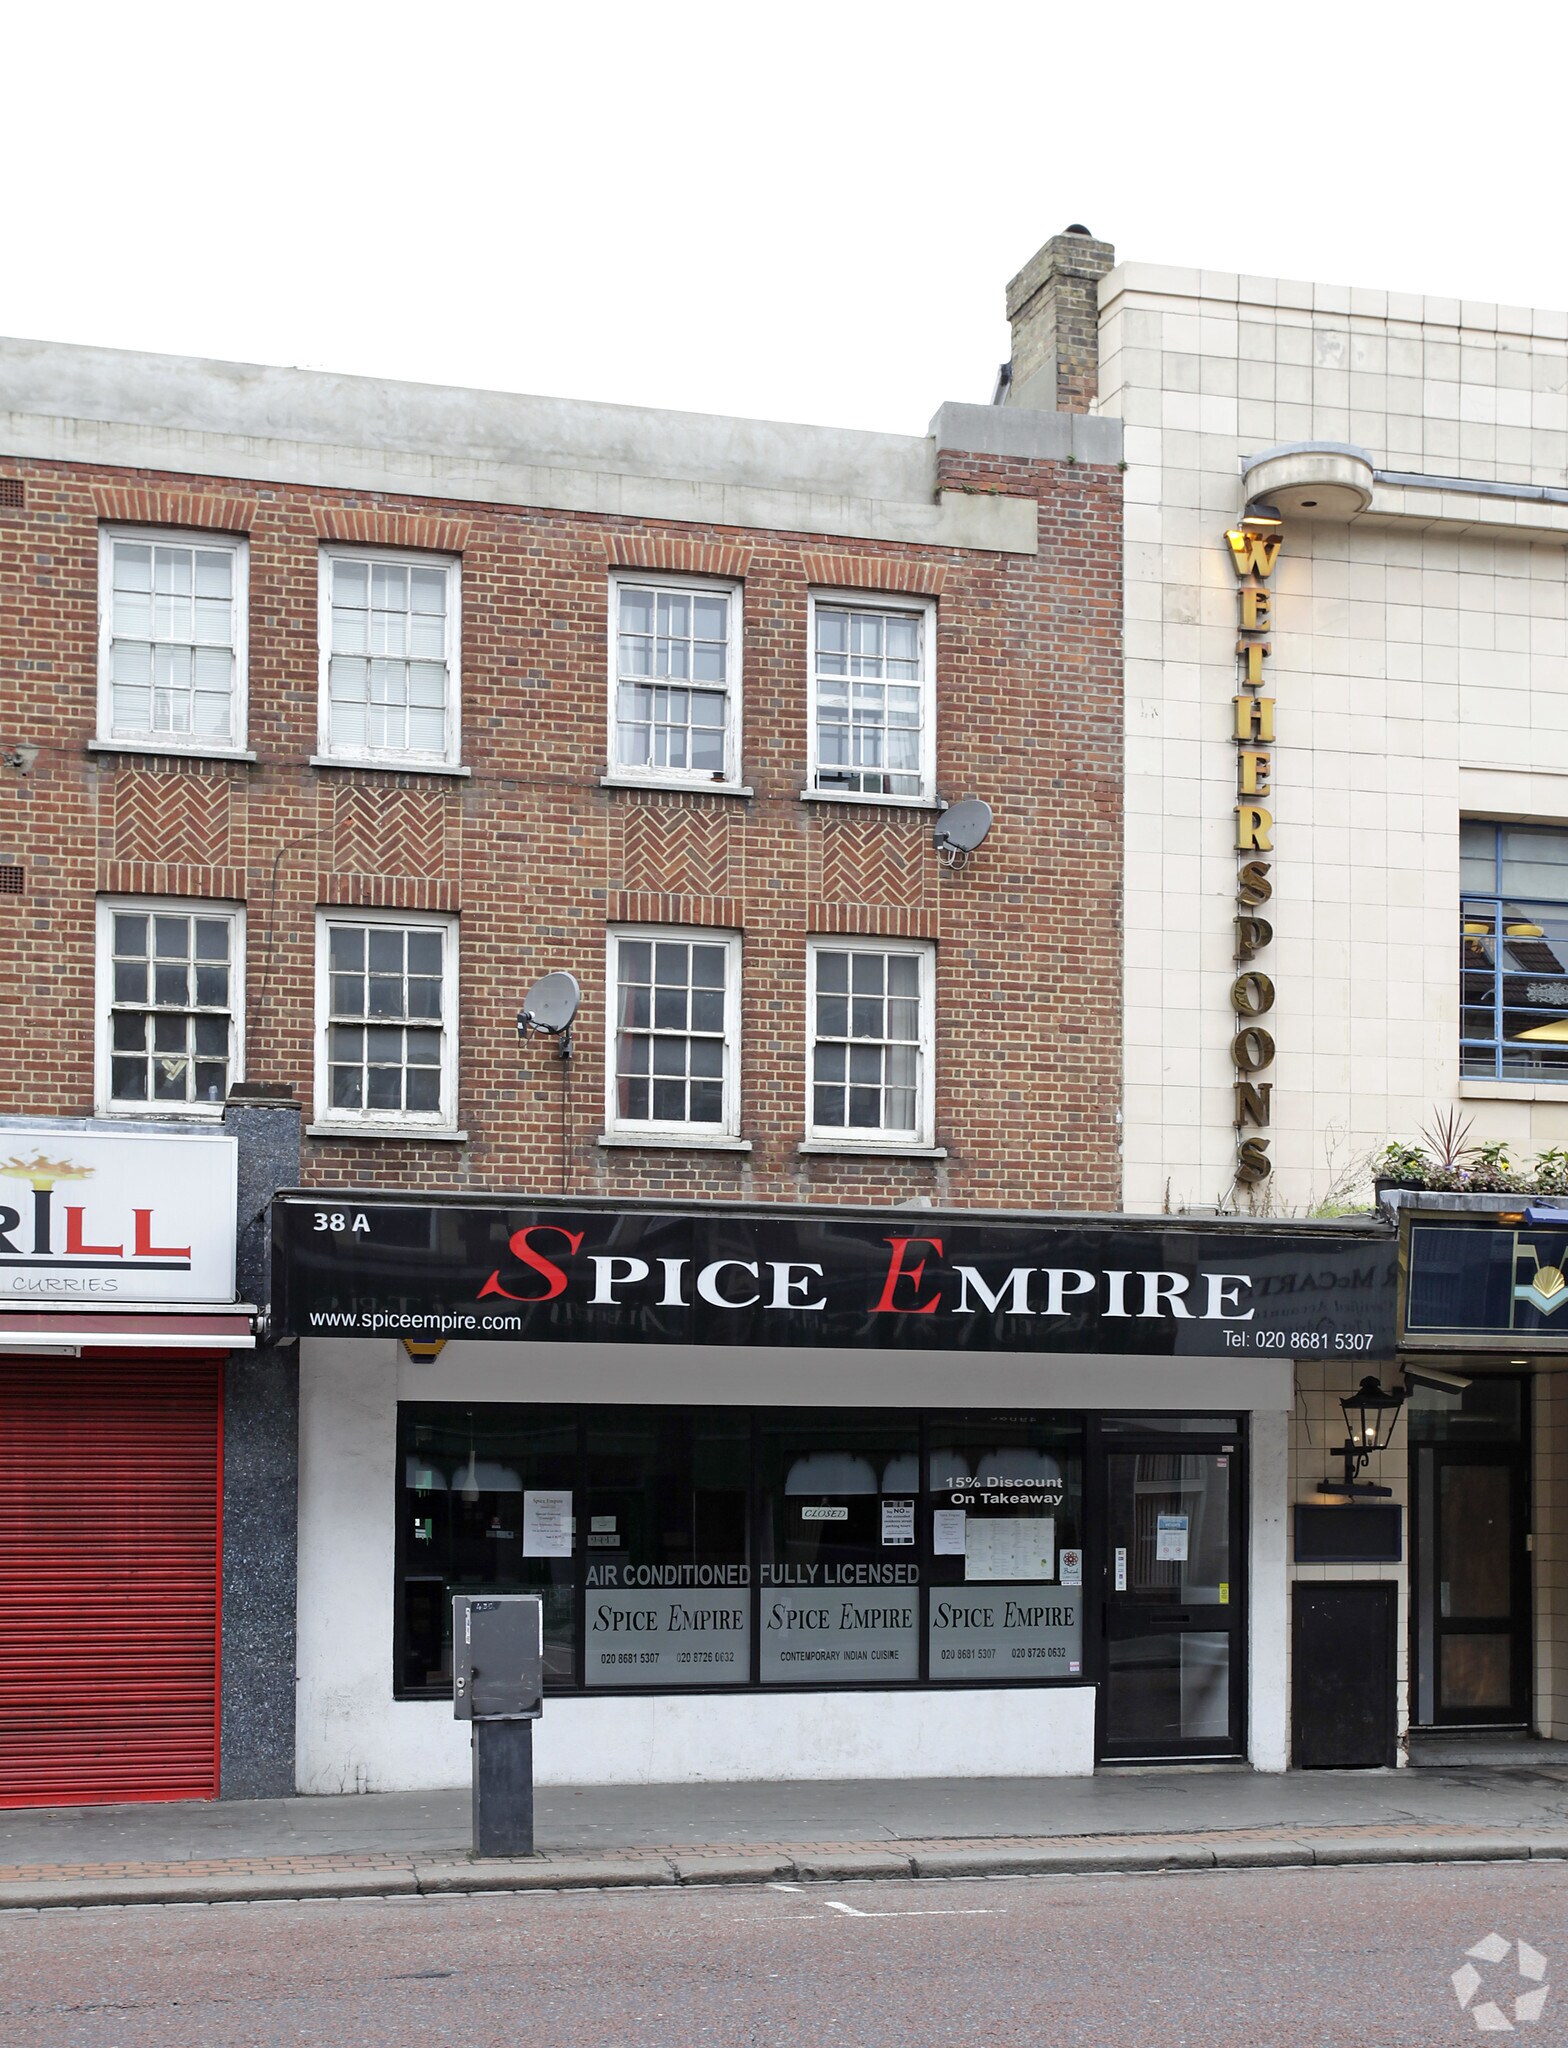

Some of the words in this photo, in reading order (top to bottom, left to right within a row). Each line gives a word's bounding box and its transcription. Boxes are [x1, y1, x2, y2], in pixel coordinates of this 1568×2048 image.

[1223, 529, 1284, 1184] WETHERSPOONS
[313, 1212, 346, 1232] 38
[351, 1213, 371, 1233] A
[476, 1225, 828, 1311] SPICE
[867, 1237, 1256, 1321] EMPIRE
[12, 1276, 119, 1292] CURRIES
[309, 1310, 521, 1332] www.spiceempire.com
[1223, 1330, 1250, 1347] Tel:
[1255, 1331, 1286, 1348] 020
[1290, 1332, 1328, 1349] 8681
[1335, 1333, 1374, 1350] 5307
[946, 1476, 981, 1488] 15%
[986, 1476, 1063, 1488] Discount
[950, 1493, 975, 1504] On
[980, 1493, 1064, 1506] Takeaway
[805, 1509, 846, 1518] CLOSED
[585, 1564, 618, 1586] AIR
[623, 1564, 750, 1586] CONDITIONED
[760, 1563, 819, 1585] FULLY
[824, 1563, 919, 1584] LICENSED
[592, 1604, 658, 1632] SPICE
[667, 1603, 744, 1632] EMPIRE
[767, 1603, 830, 1630] SPICE
[838, 1602, 913, 1630] EMPIRE
[933, 1602, 995, 1629] SPICE
[1003, 1601, 1075, 1628] EMPIRE
[601, 1653, 616, 1664] 020
[618, 1653, 637, 1664] 8681
[640, 1652, 660, 1663] 5307
[676, 1652, 691, 1663] 020
[693, 1651, 713, 1663] 8726
[715, 1651, 735, 1662] 0632
[780, 1650, 840, 1661] CONTEMPORARY
[843, 1650, 867, 1660] INDIAN
[871, 1649, 899, 1660] CUISINE
[941, 1649, 956, 1660] 020
[957, 1649, 976, 1659] 8681
[978, 1648, 996, 1659] 5307
[1012, 1648, 1026, 1658] 020
[1027, 1647, 1046, 1658] 8726
[1047, 1647, 1066, 1658] 0632
